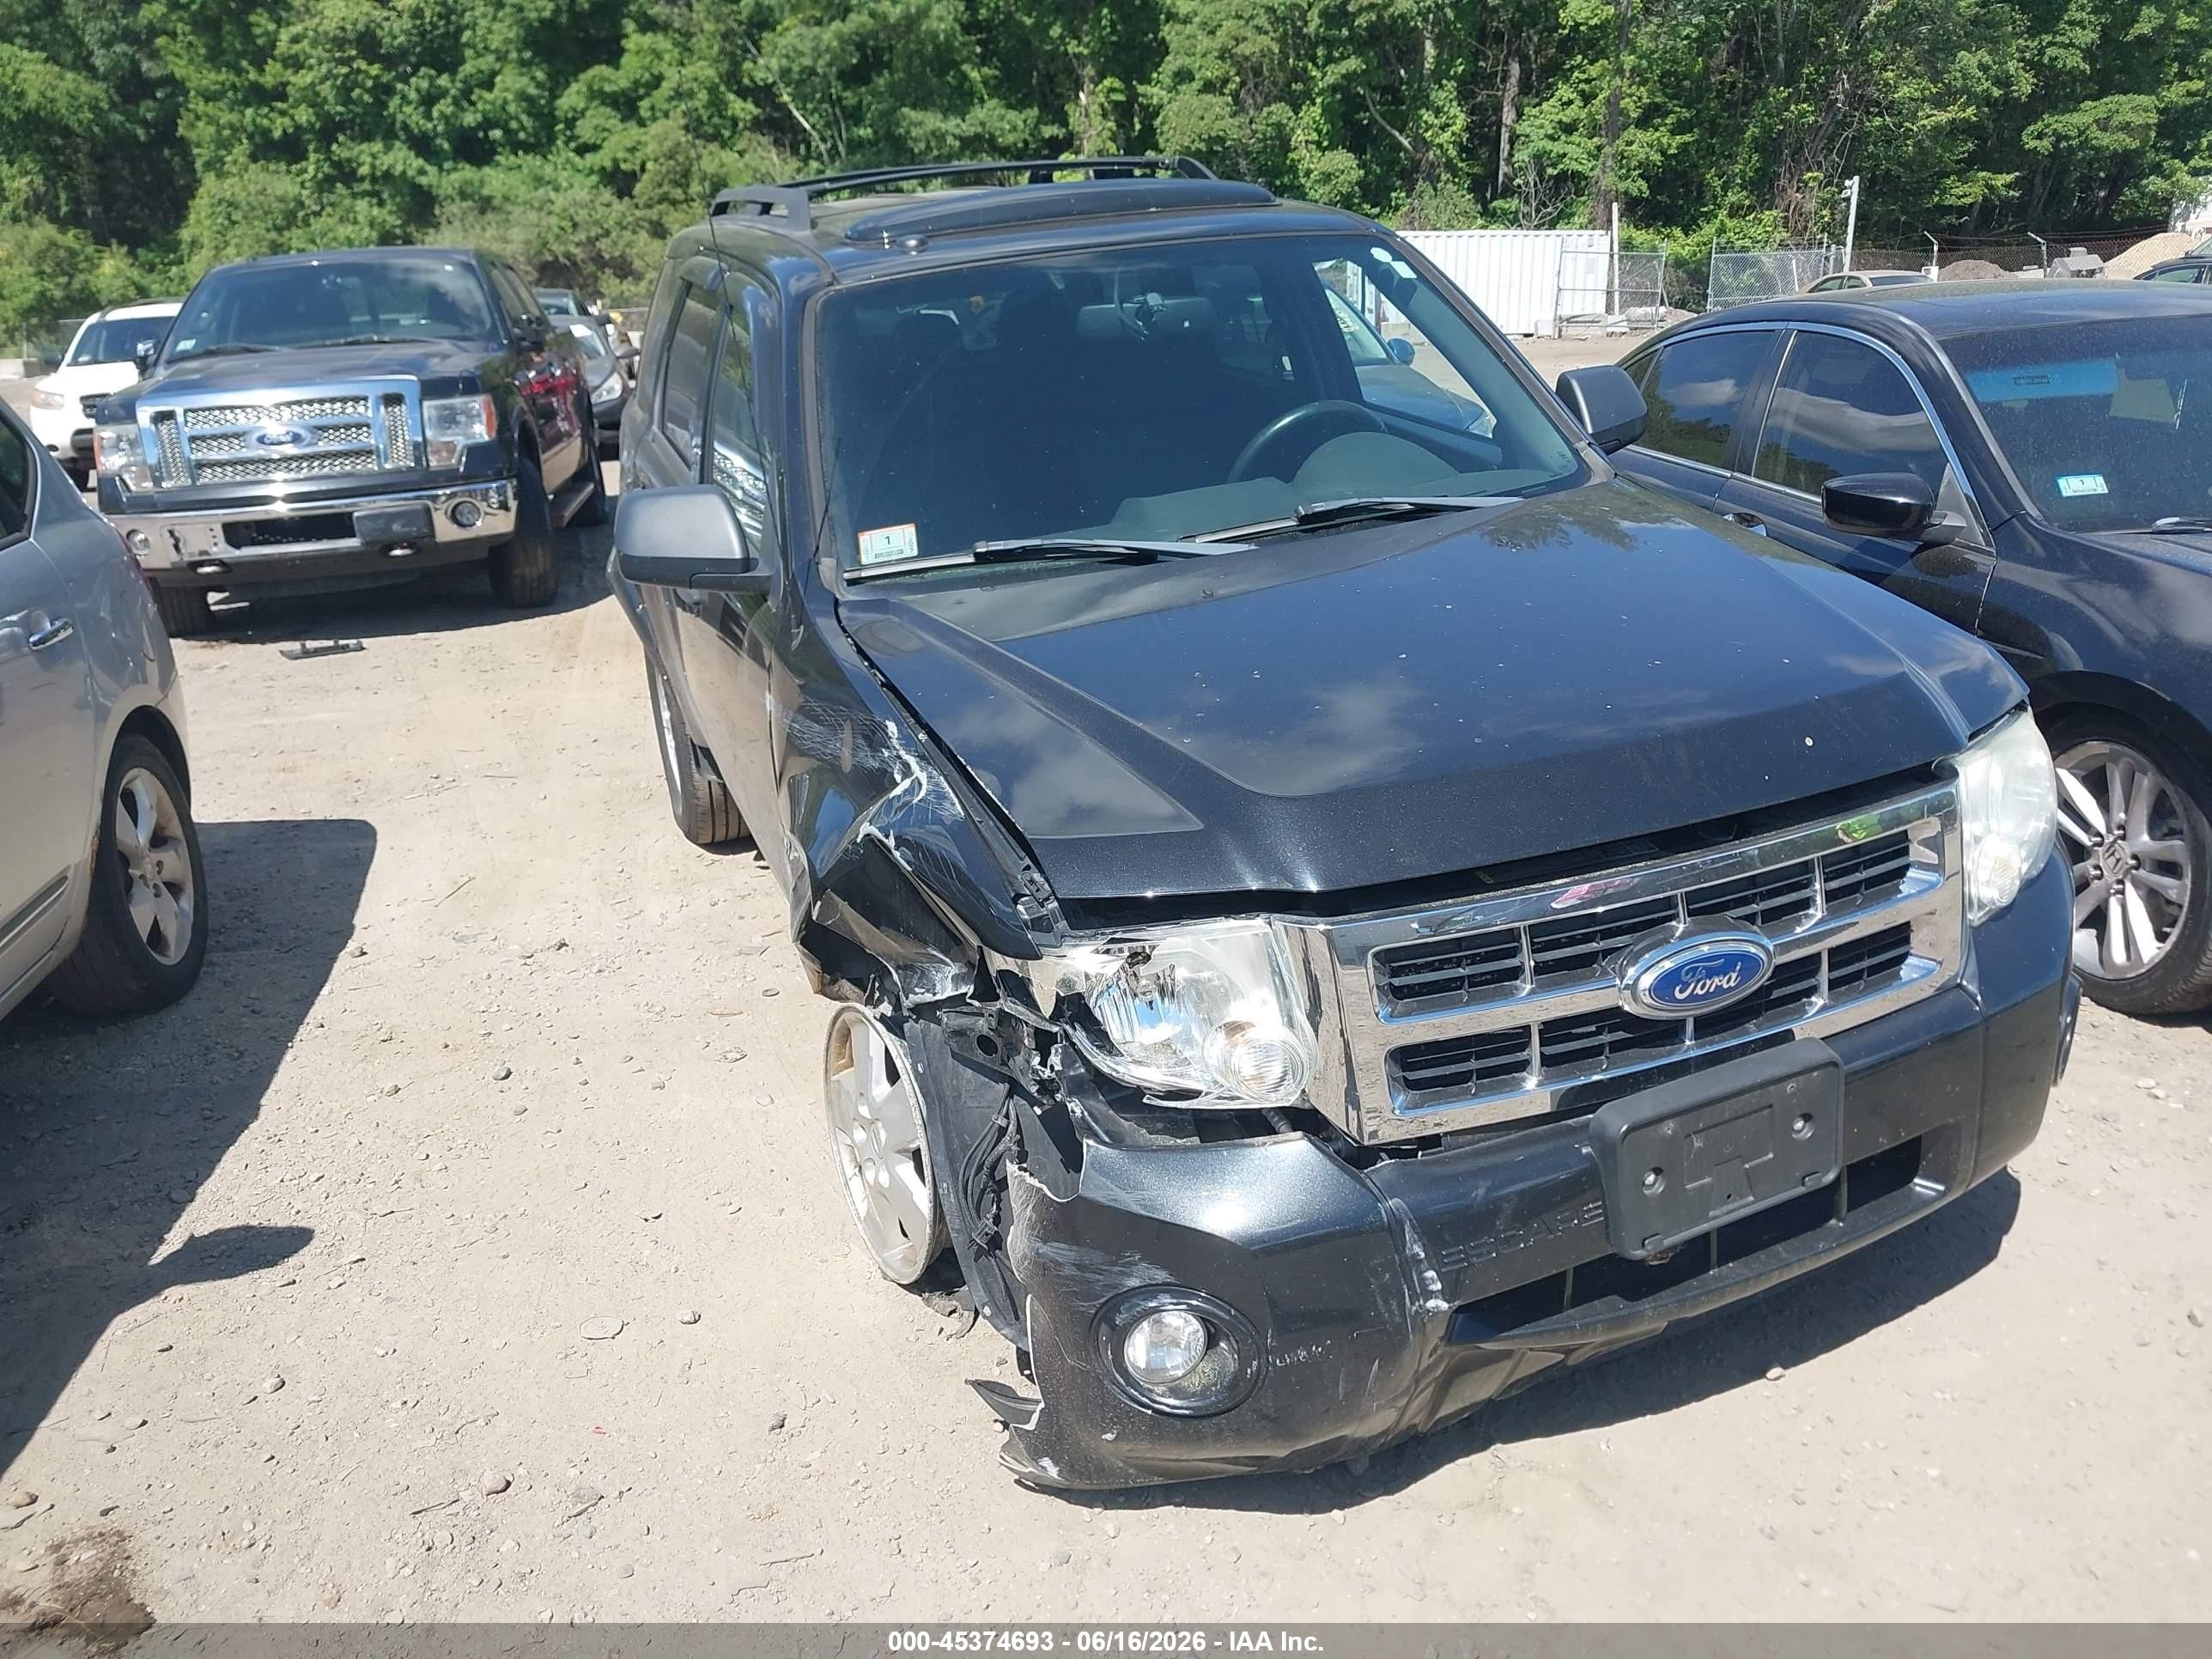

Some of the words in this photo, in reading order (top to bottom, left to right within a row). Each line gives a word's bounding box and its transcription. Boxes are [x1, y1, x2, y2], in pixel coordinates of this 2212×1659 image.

[884, 535, 891, 545] 1
[1674, 958, 1741, 1000] Ford
[1436, 1201, 1605, 1273] ESCAPE
